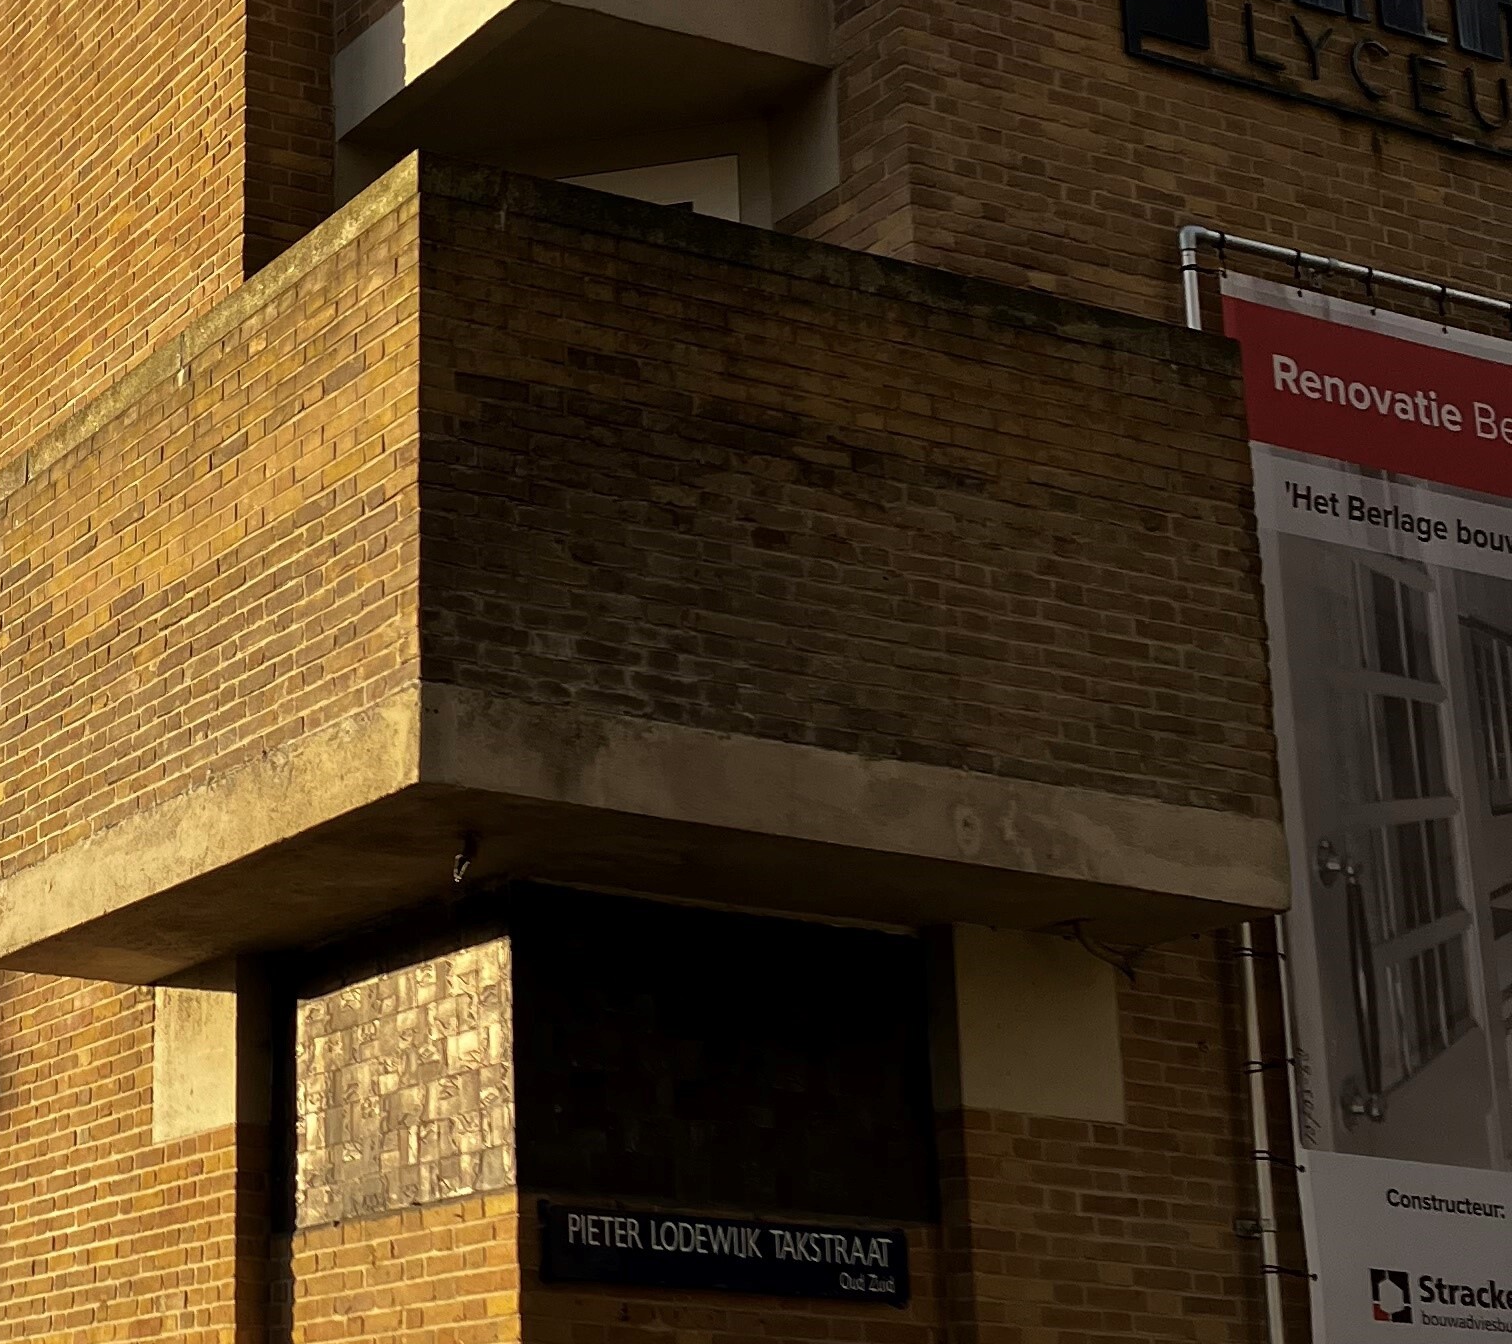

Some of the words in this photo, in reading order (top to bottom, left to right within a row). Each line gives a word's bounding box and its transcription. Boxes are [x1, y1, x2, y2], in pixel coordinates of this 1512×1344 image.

[1241, 1, 1509, 129] LYCEU
[1272, 354, 1463, 432] Renovatie
[1473, 401, 1512, 445] Be
[1348, 494, 1448, 543] Berlage
[1386, 1188, 1506, 1219] Constructeur:
[567, 1213, 644, 1250] PIETER
[650, 1219, 763, 1258] LODEWIJK
[769, 1229, 893, 1268] TAKSTRAAT
[839, 1272, 866, 1292] Oud
